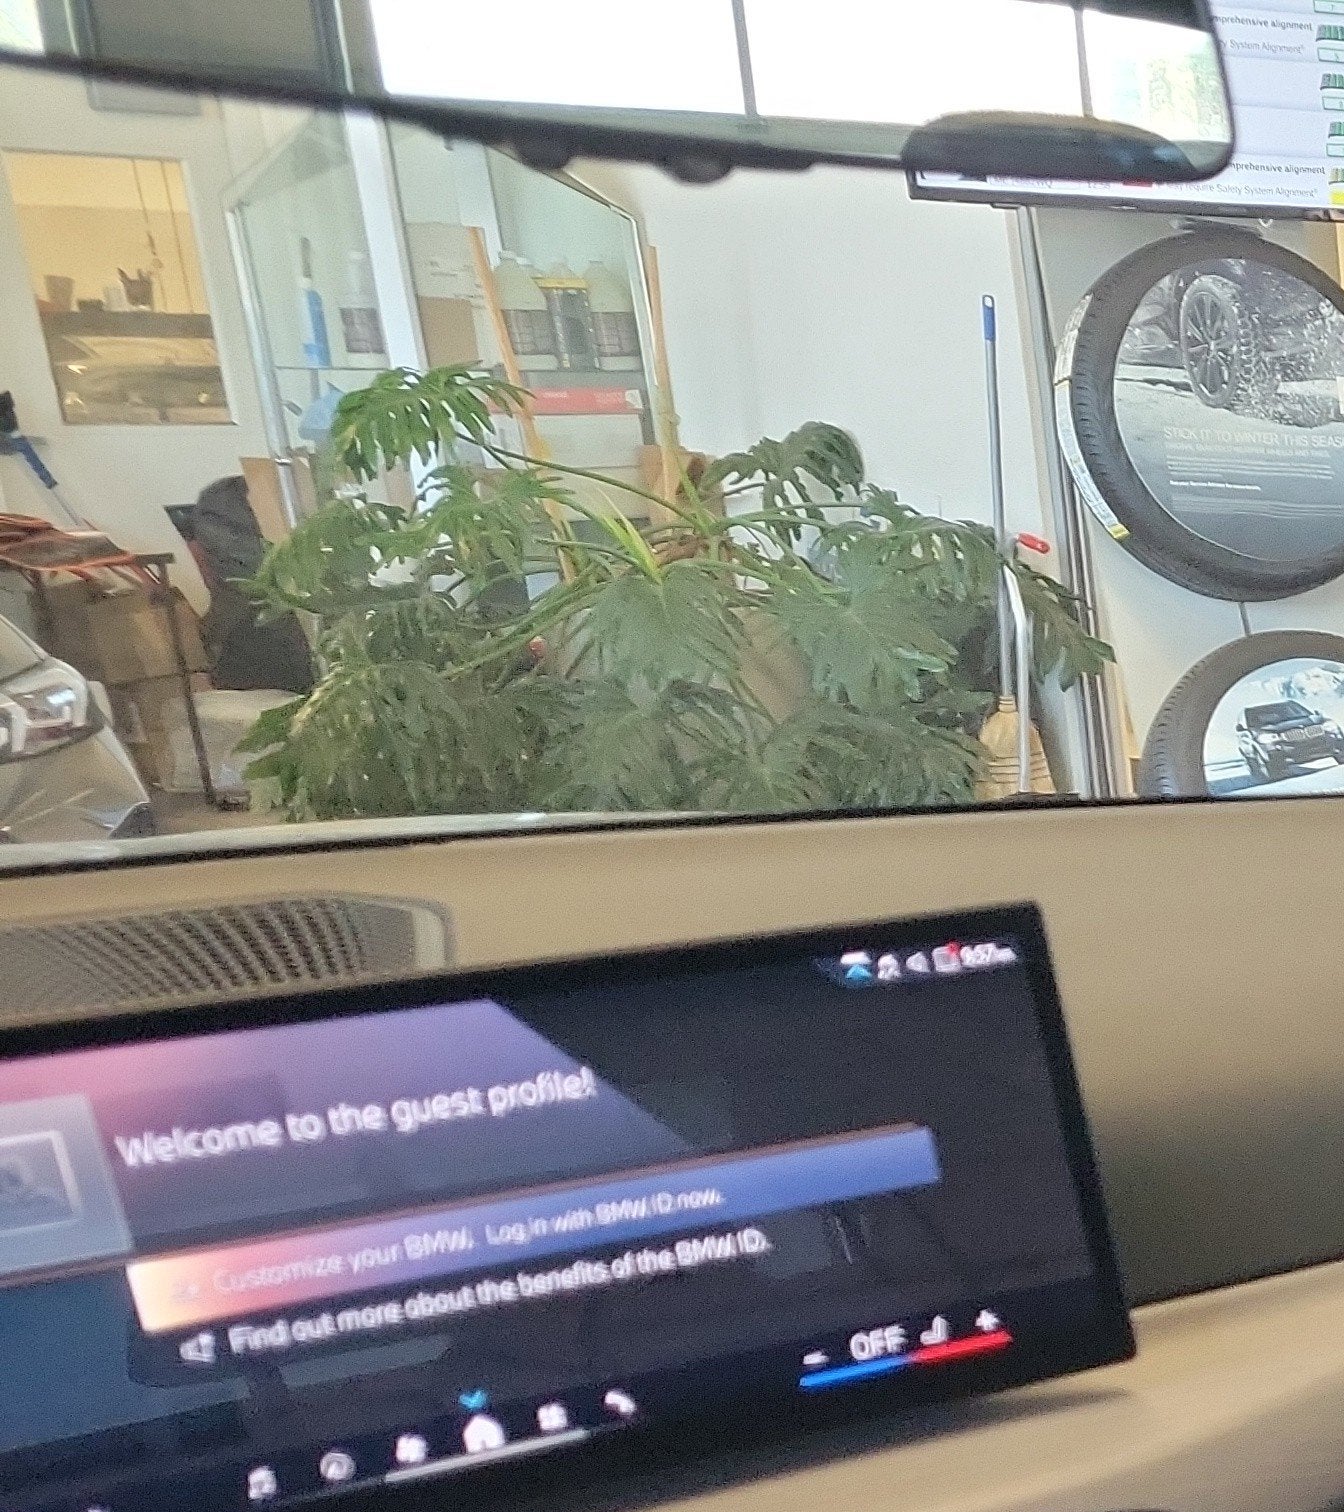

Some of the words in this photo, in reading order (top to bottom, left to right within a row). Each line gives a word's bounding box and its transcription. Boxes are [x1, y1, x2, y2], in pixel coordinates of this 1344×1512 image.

[1212, 15, 1269, 28] mprehensive
[1270, 19, 1314, 32] alignment
[1229, 39, 1260, 51] System
[1284, 165, 1326, 176] alignment
[1244, 185, 1274, 197] System
[1232, 431, 1280, 446] WINTER
[1282, 434, 1309, 447] THIS
[114, 1118, 282, 1167] Welcome
[286, 1110, 324, 1142] to
[328, 1102, 386, 1134] the
[391, 1087, 485, 1134] guest
[487, 1066, 598, 1117] profile!
[214, 1254, 343, 1292] Customize
[352, 1244, 399, 1274] your
[484, 1221, 528, 1246] Log
[529, 1216, 548, 1236] in
[553, 1206, 594, 1233] with
[596, 1196, 649, 1225] BMW
[228, 1318, 291, 1355] Find
[292, 1311, 337, 1343] out
[337, 1300, 404, 1334] more
[405, 1284, 476, 1321] about
[476, 1277, 518, 1305] the
[517, 1259, 611, 1296] benefits
[611, 1251, 639, 1281] of
[638, 1247, 677, 1276] the
[675, 1231, 736, 1268] BMW
[850, 1323, 908, 1361] OFF
